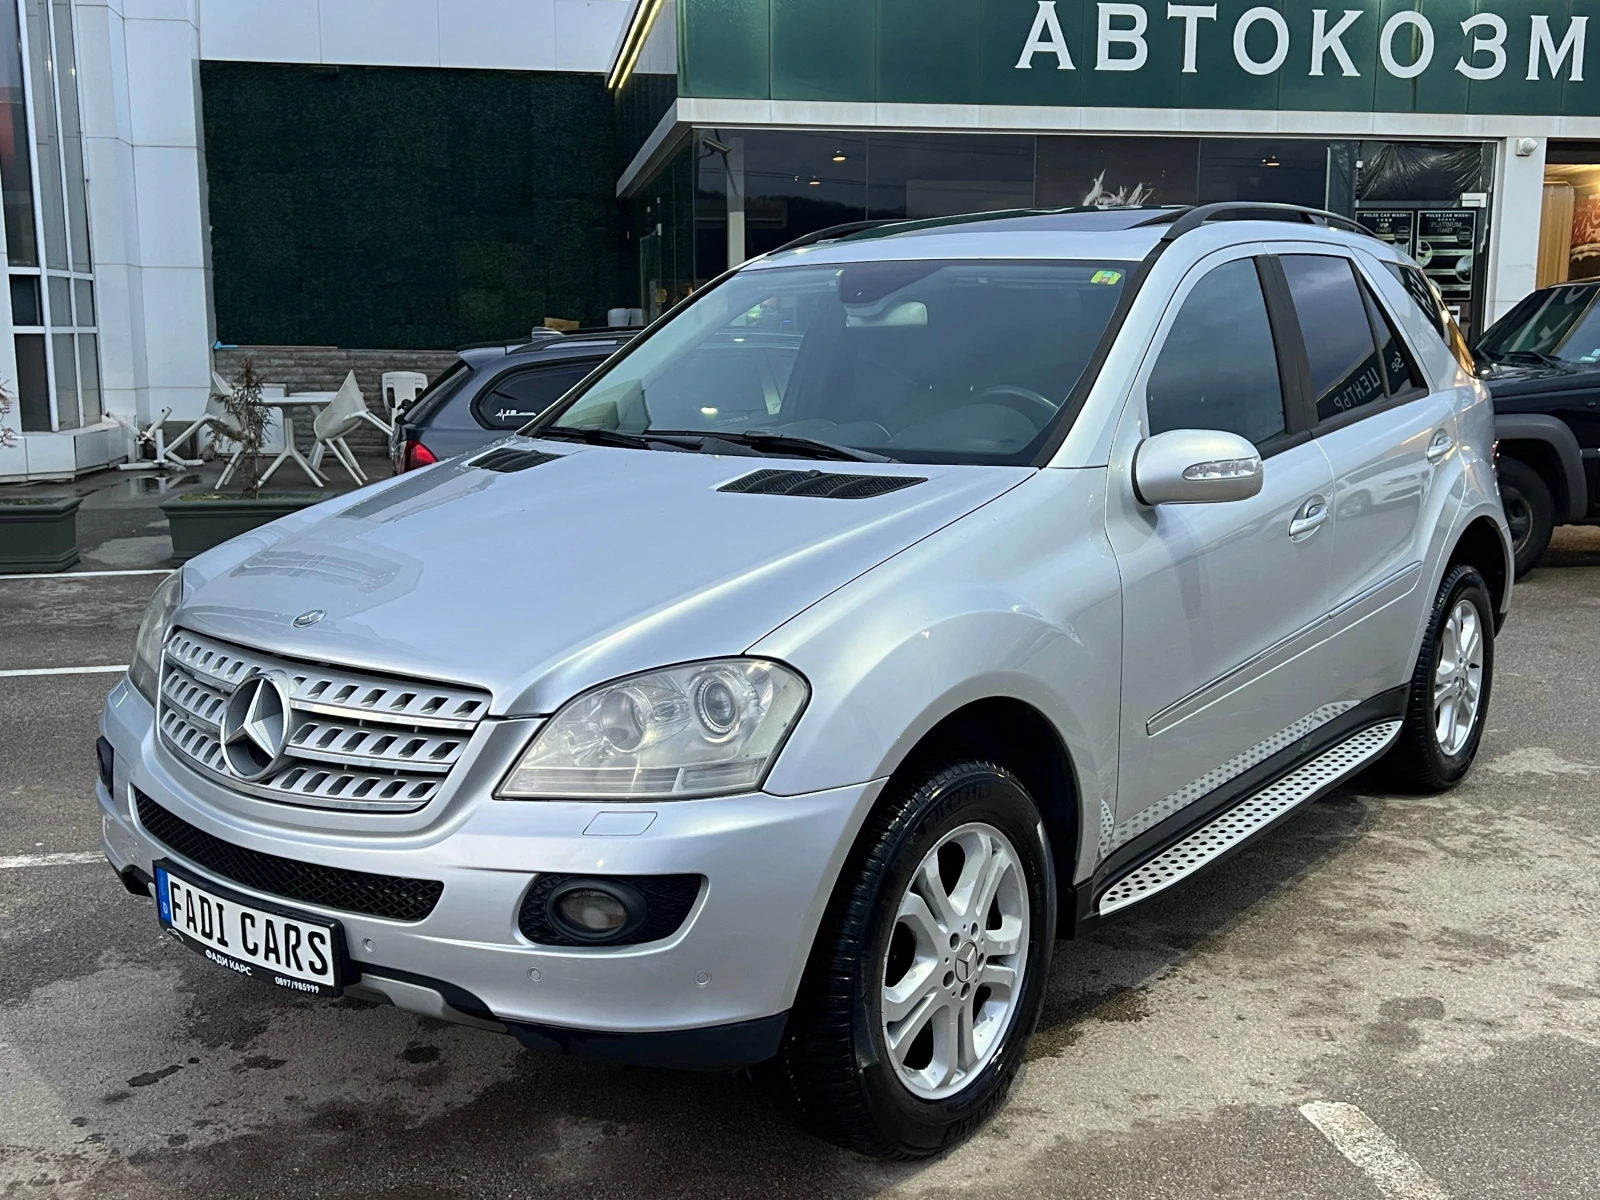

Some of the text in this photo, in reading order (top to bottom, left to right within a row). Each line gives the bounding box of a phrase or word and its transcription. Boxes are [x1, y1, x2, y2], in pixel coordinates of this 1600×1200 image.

[170, 881, 328, 975] FADI CARS
[205, 949, 252, 976] ФАДИ КАРС
[274, 976, 319, 994] 0897/985999
